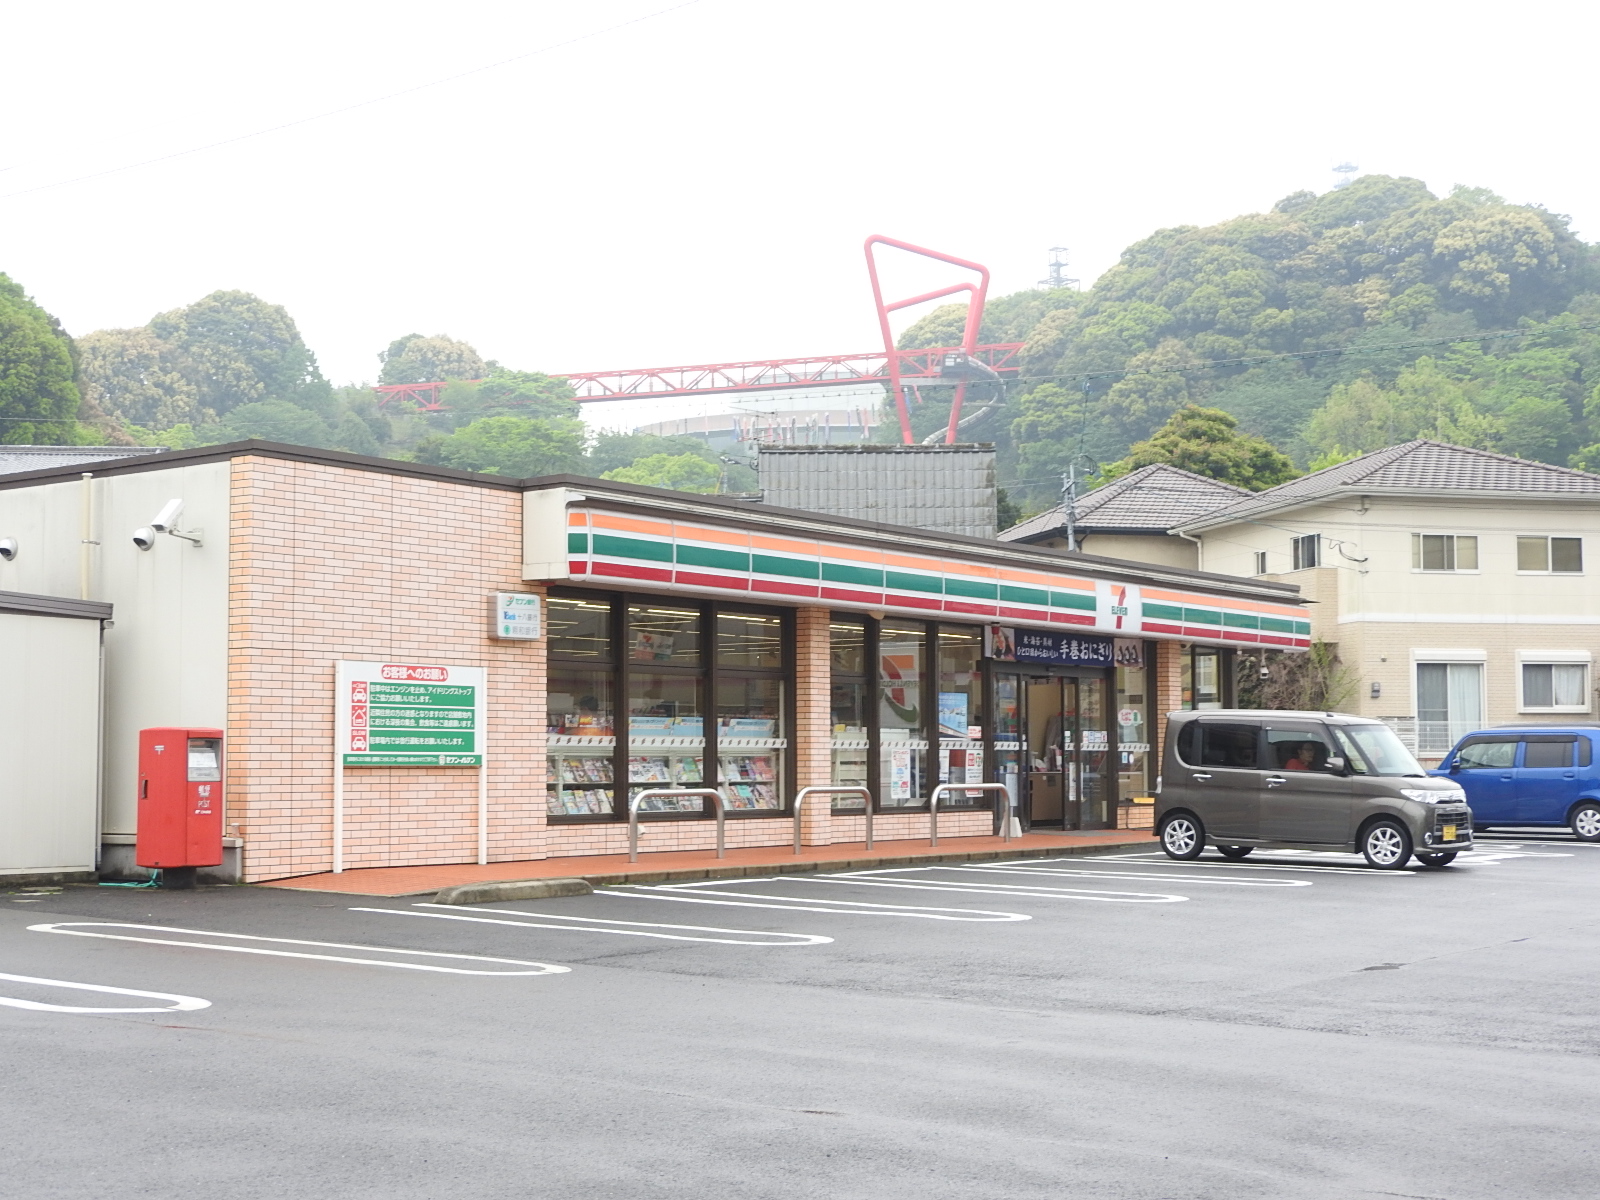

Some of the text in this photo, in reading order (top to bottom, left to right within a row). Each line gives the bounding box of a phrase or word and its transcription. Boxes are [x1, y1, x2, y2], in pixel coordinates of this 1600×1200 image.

[1060, 640, 1113, 661] 手巻おにぎり
[382, 666, 448, 680] お客様へのお願い
[198, 800, 210, 808] POST
